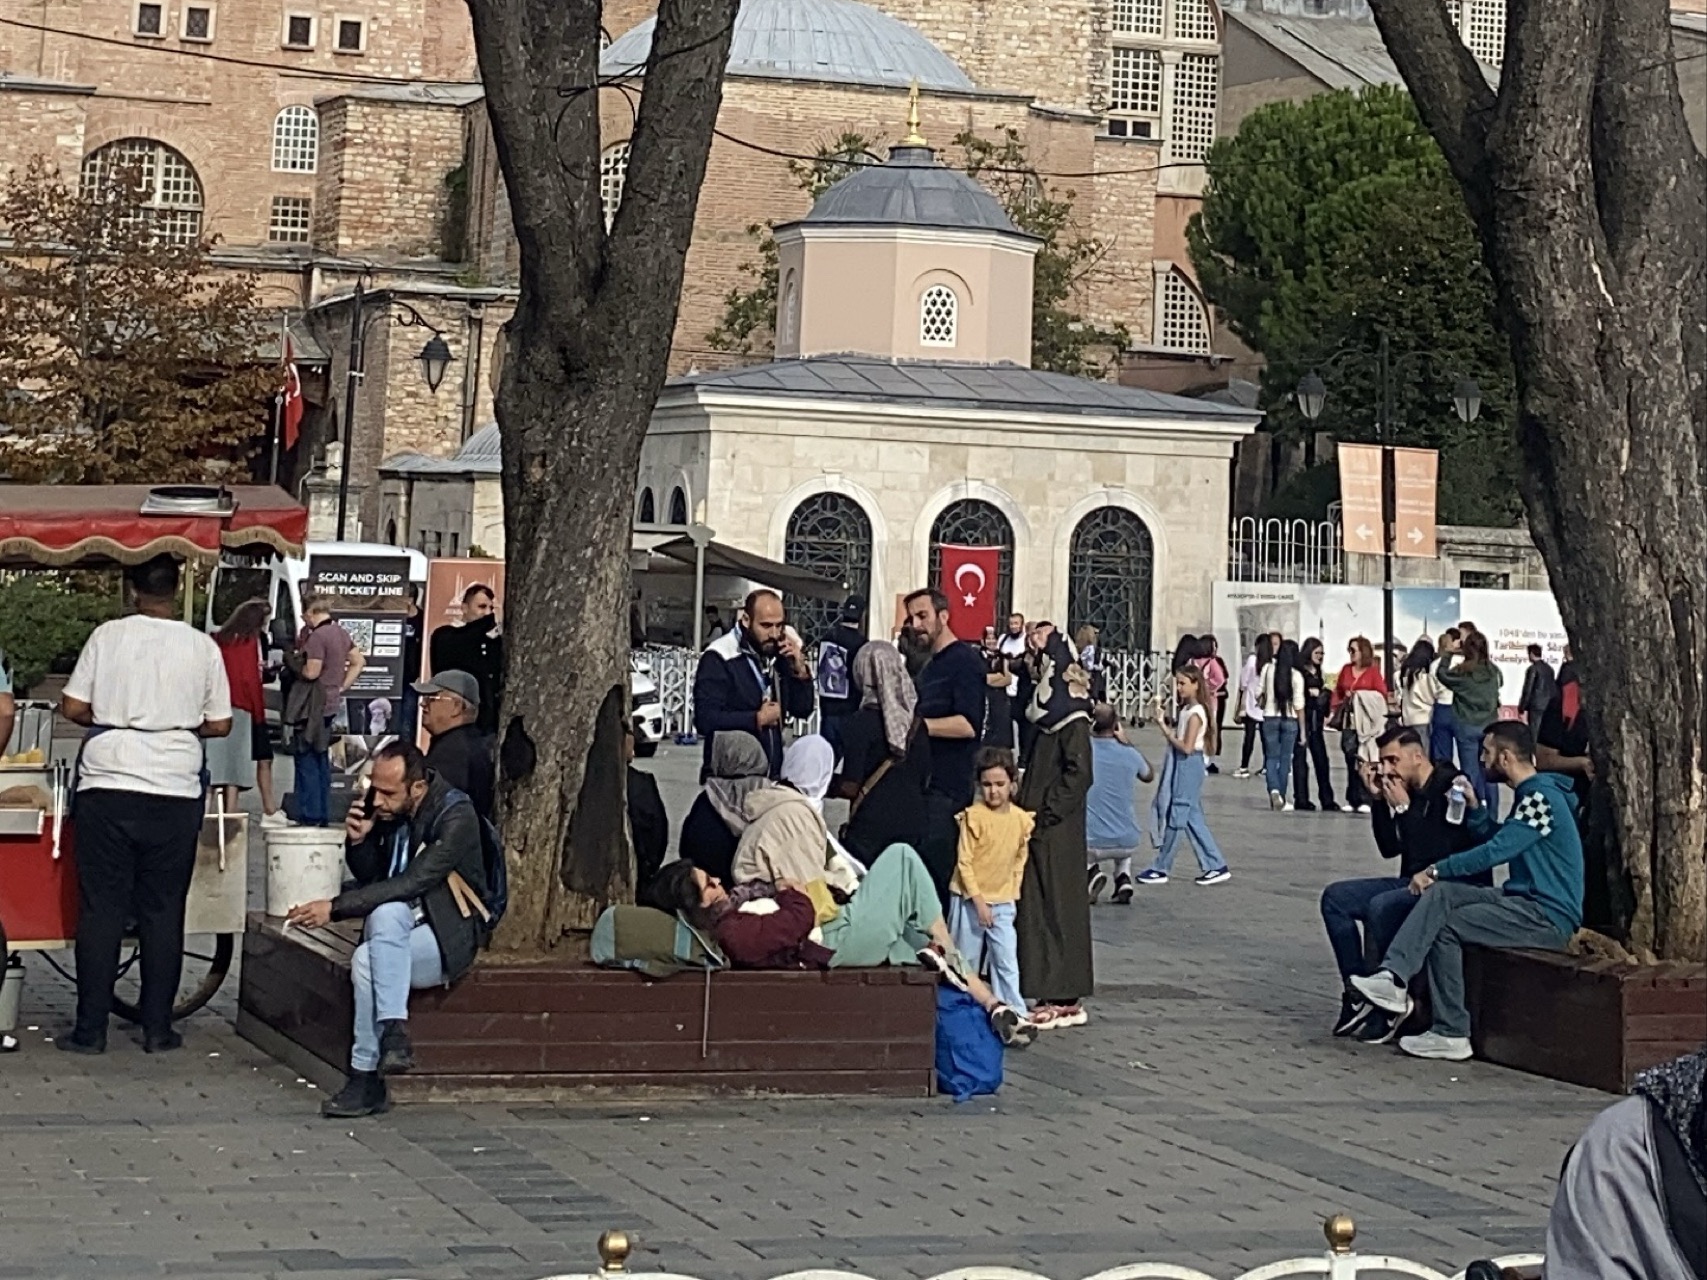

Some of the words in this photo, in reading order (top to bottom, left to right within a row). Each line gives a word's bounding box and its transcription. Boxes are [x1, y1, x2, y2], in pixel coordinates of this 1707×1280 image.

[318, 572, 348, 582] SCAN
[350, 573, 375, 583] AND
[376, 574, 402, 584] SKIP
[314, 584, 336, 595] THE
[338, 585, 377, 596] TICKET
[378, 586, 404, 596] LINE
